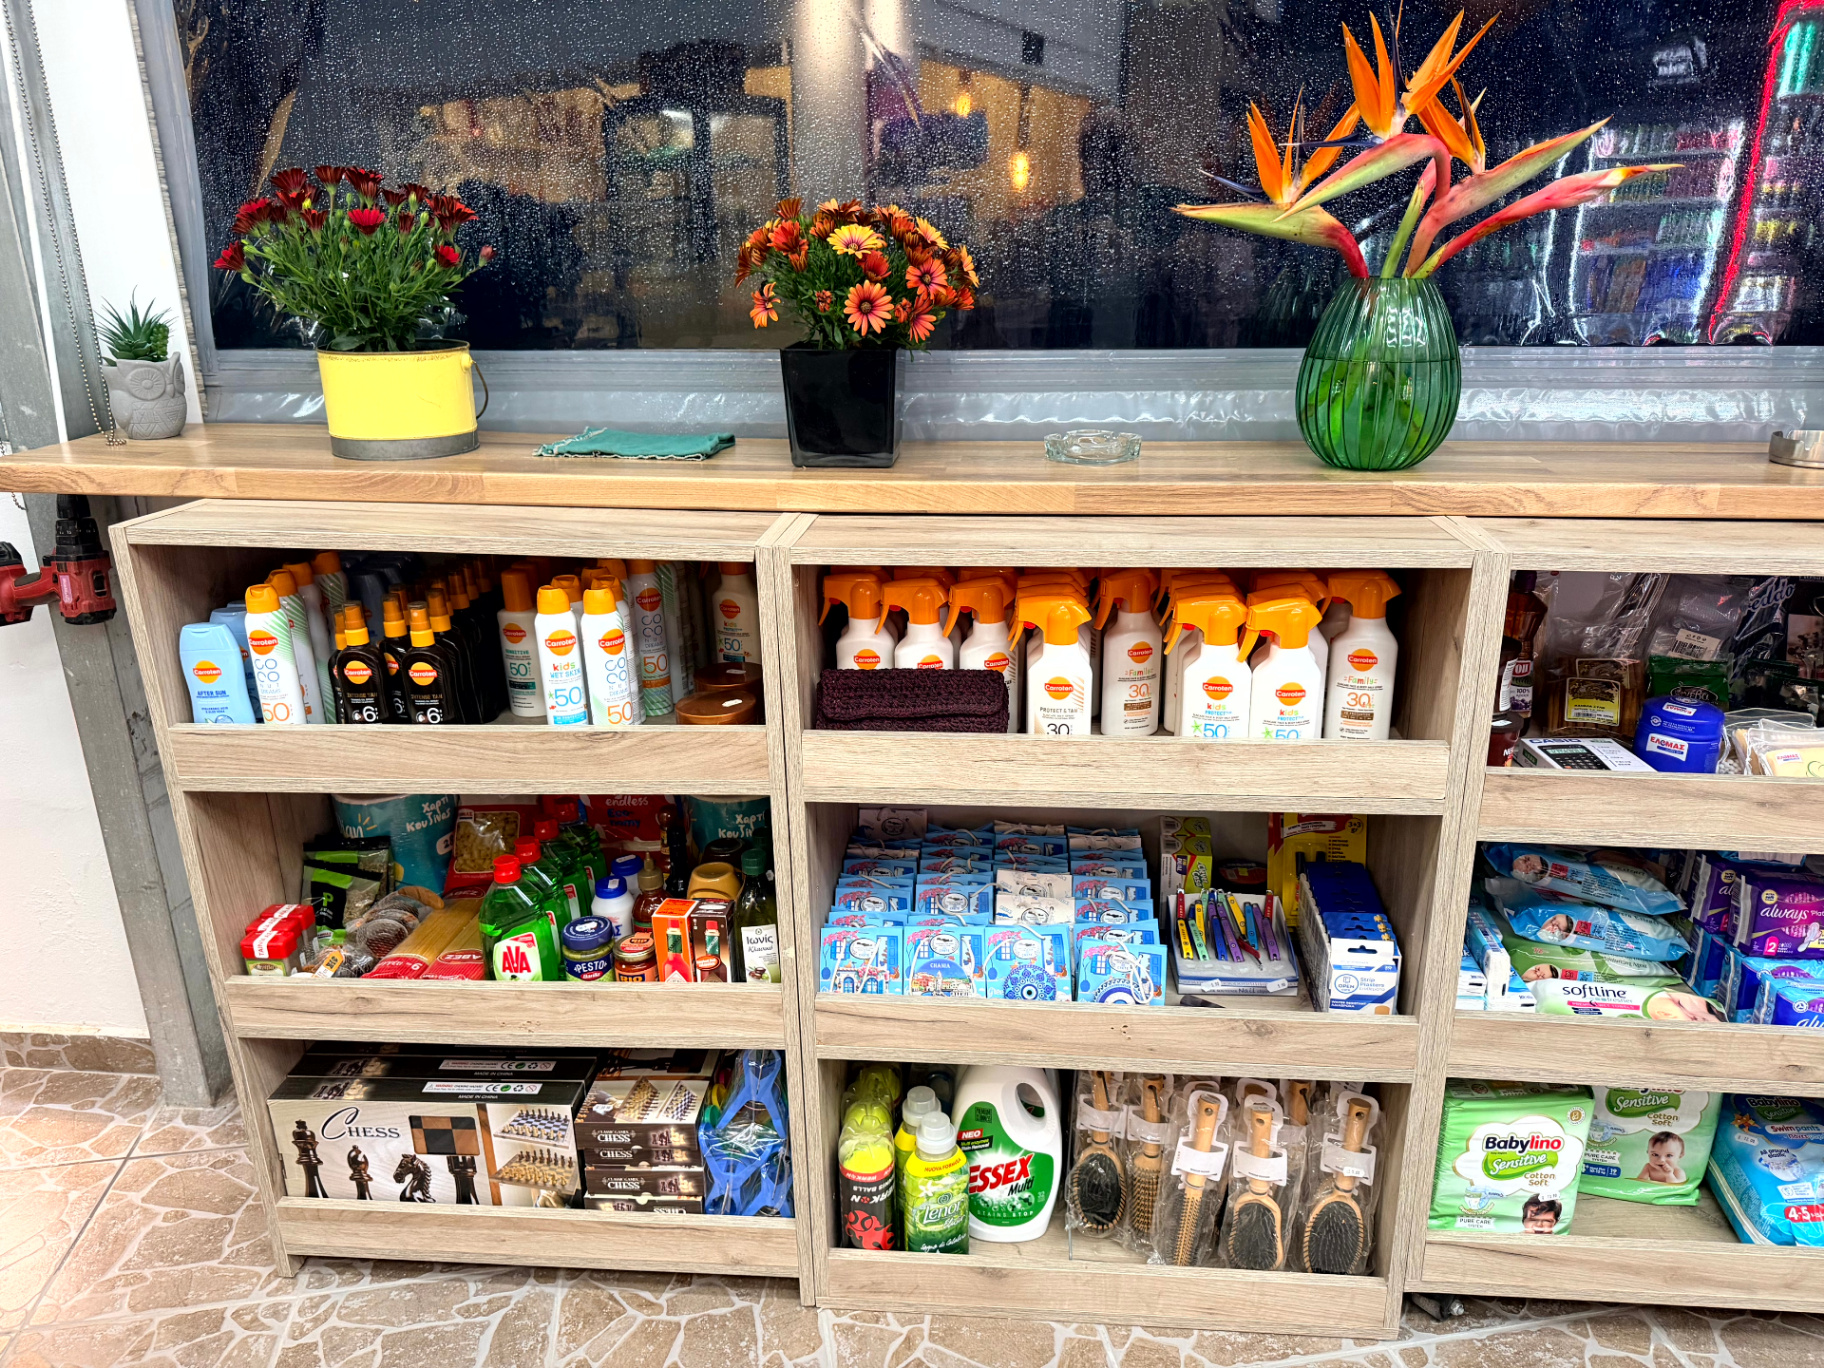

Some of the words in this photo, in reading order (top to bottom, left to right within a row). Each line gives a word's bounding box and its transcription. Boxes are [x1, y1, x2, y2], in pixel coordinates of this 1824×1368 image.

[249, 638, 278, 648] Carroten
[546, 637, 577, 648] Carroten
[1128, 648, 1153, 657] Carroten
[643, 654, 668, 674] 50
[854, 656, 881, 664] Carroten
[984, 659, 1009, 667] Carroten
[1348, 656, 1378, 665] Carroten
[552, 662, 576, 672] kids
[917, 662, 943, 670] Carroten
[193, 668, 222, 676] Carroten
[1348, 676, 1374, 686] Family
[1045, 684, 1074, 692] Carroten
[1128, 684, 1150, 699] 30
[1203, 684, 1233, 692] Carroten
[554, 686, 582, 707] 50
[1276, 690, 1306, 698] Carroten
[1347, 692, 1371, 707] 30
[261, 702, 290, 722] 50
[1207, 703, 1227, 711] kids
[362, 706, 377, 722] 6
[427, 707, 441, 724] 6
[607, 701, 633, 725] 50
[1046, 723, 1070, 735] 30
[1203, 723, 1228, 738] 50
[605, 795, 650, 807] endless
[1760, 904, 1810, 924] always
[1767, 943, 1777, 952] 2
[502, 945, 532, 974] AVA
[575, 960, 606, 974] PESTO
[1562, 983, 1628, 999] softline
[1613, 1095, 1669, 1112] Sensitive
[1748, 1097, 1800, 1109] Babylino
[1647, 1113, 1679, 1121] Cotton
[597, 1133, 631, 1143] CHESS
[961, 1130, 981, 1139] NEO
[1484, 1134, 1562, 1155] Babylino
[600, 1150, 634, 1159] CHESS
[1490, 1152, 1548, 1175] Sensitive
[969, 1153, 1035, 1195] ESSEX
[1524, 1172, 1556, 1180] Cotton
[607, 1181, 640, 1190] CHESS
[1008, 1176, 1036, 1197] Multi
[1528, 1179, 1550, 1187] Soft
[923, 1198, 965, 1225] Lenor
